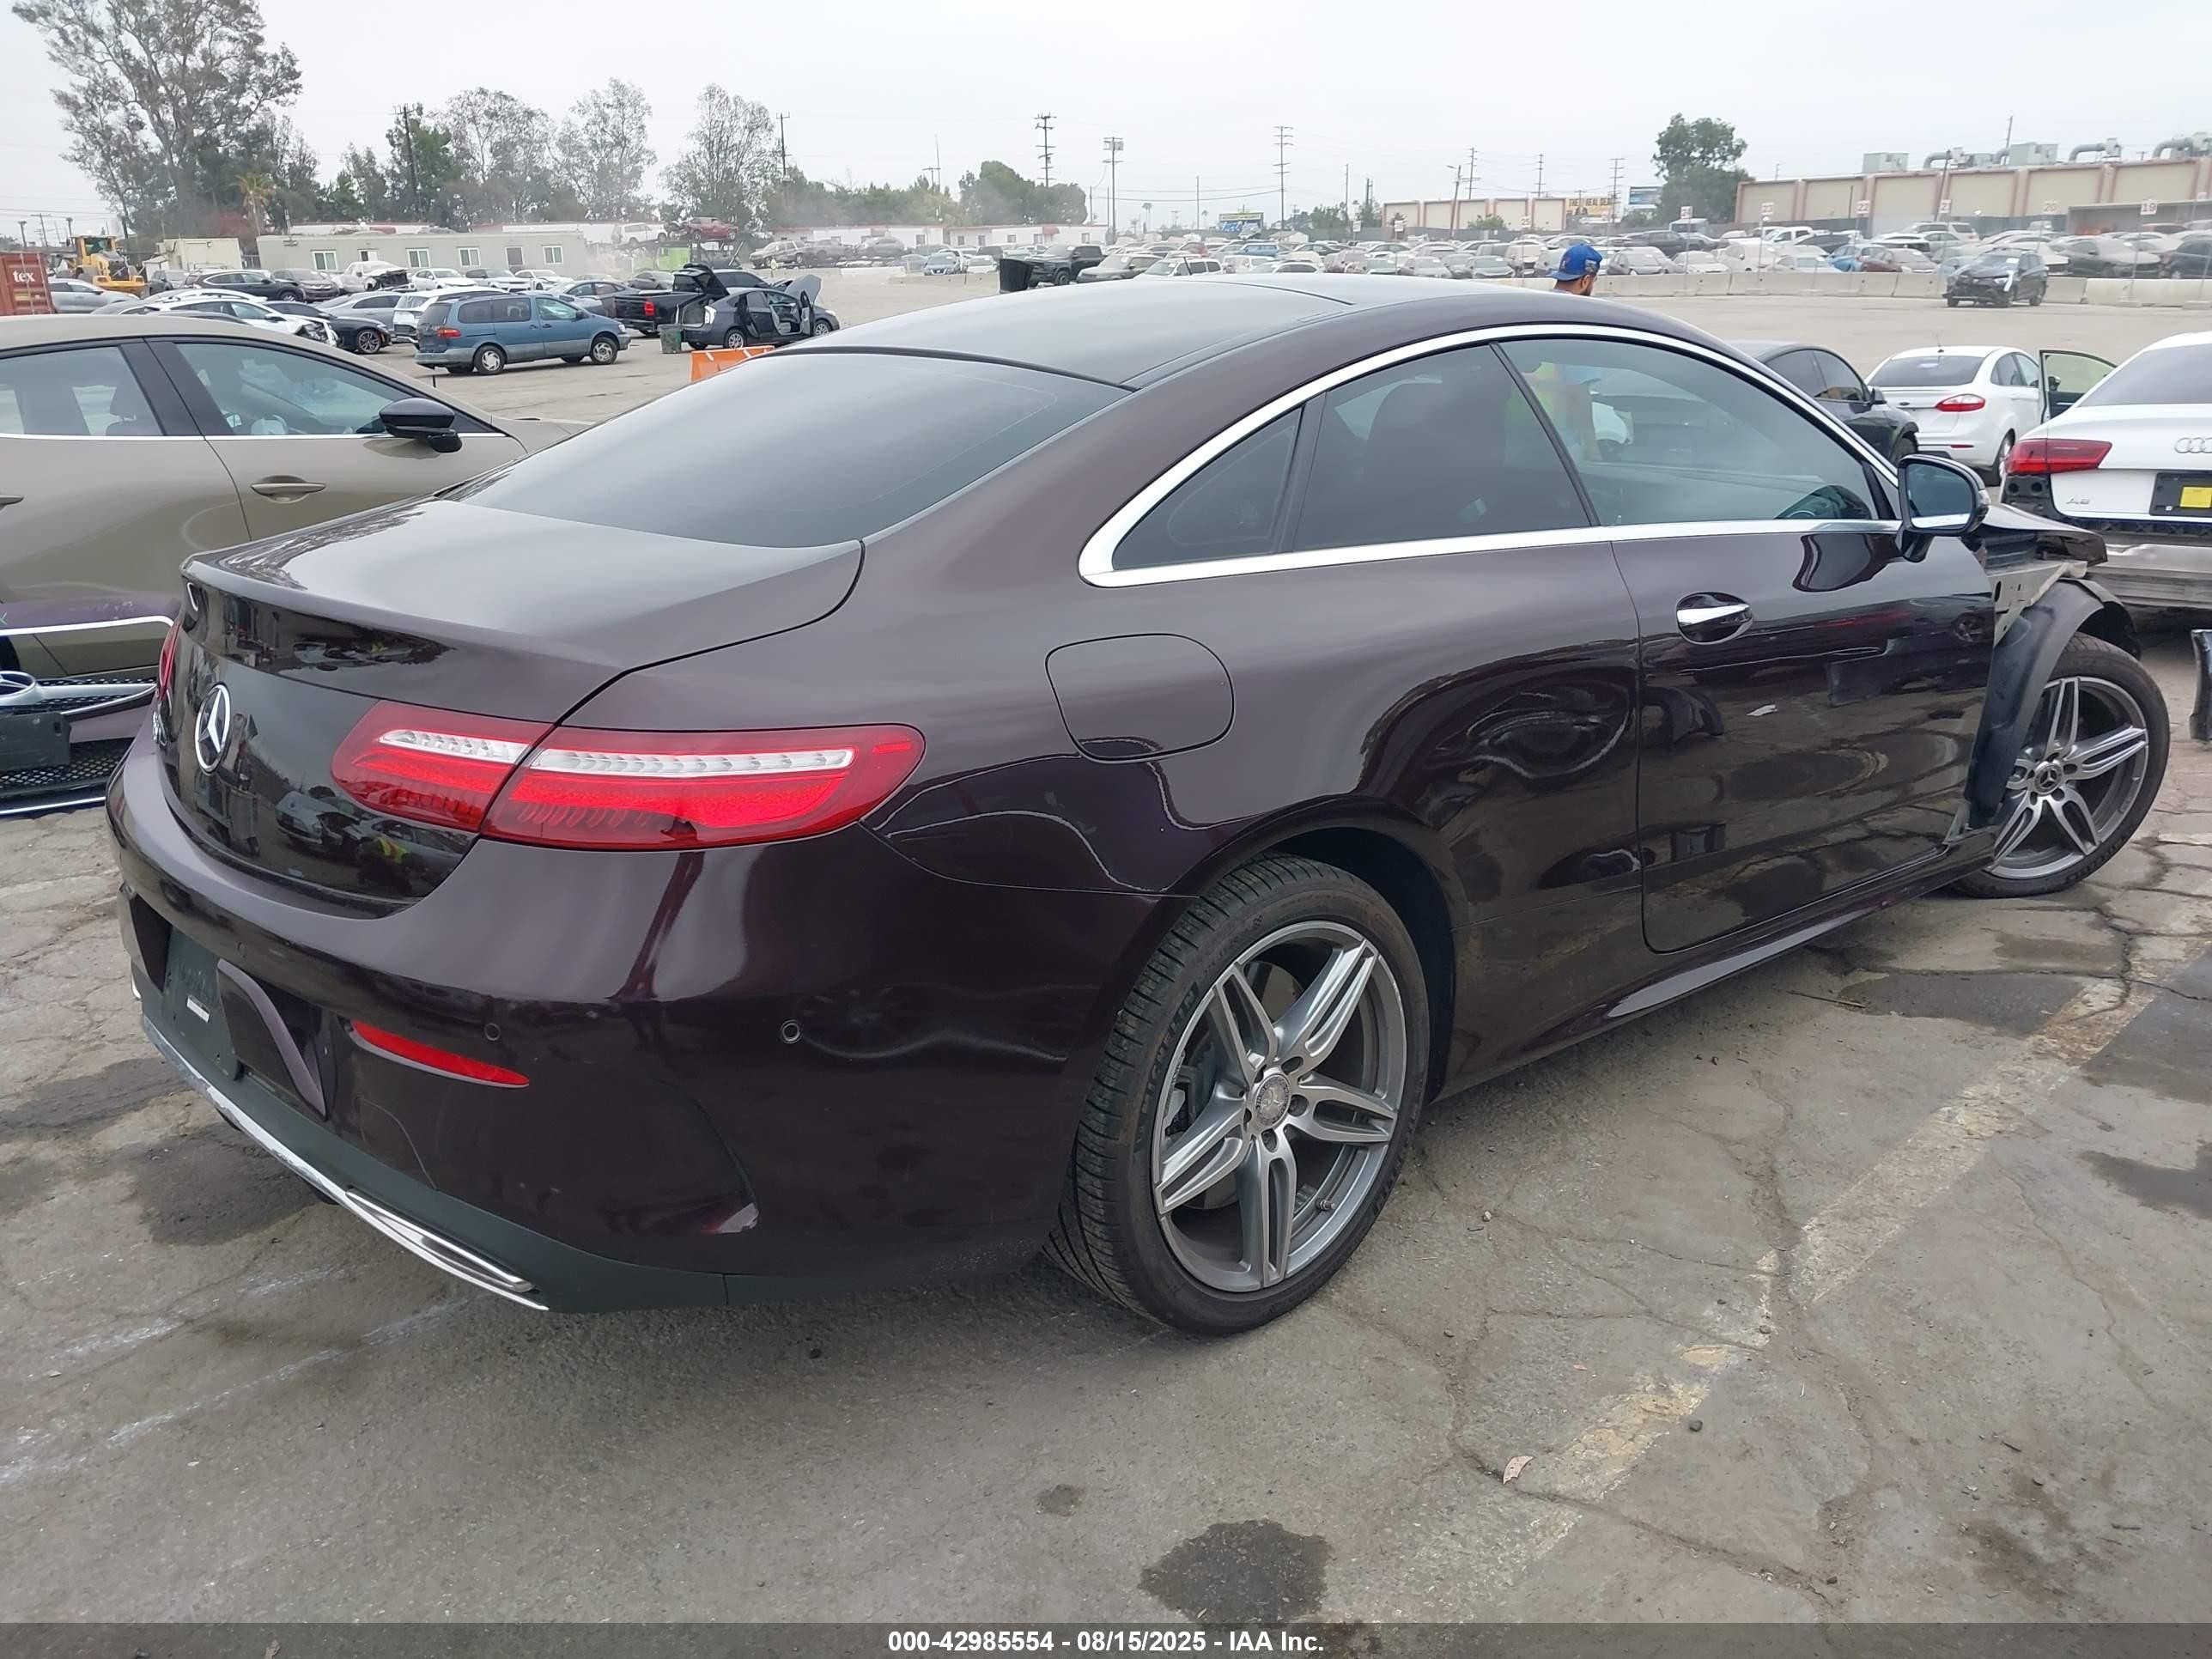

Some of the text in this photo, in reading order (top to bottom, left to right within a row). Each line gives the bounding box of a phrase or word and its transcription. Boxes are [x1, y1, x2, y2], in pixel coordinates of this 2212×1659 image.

[1856, 203, 1869, 211] 22
[2142, 203, 2156, 212] 19
[1521, 217, 1530, 226] 25
[13, 270, 35, 283] tex
